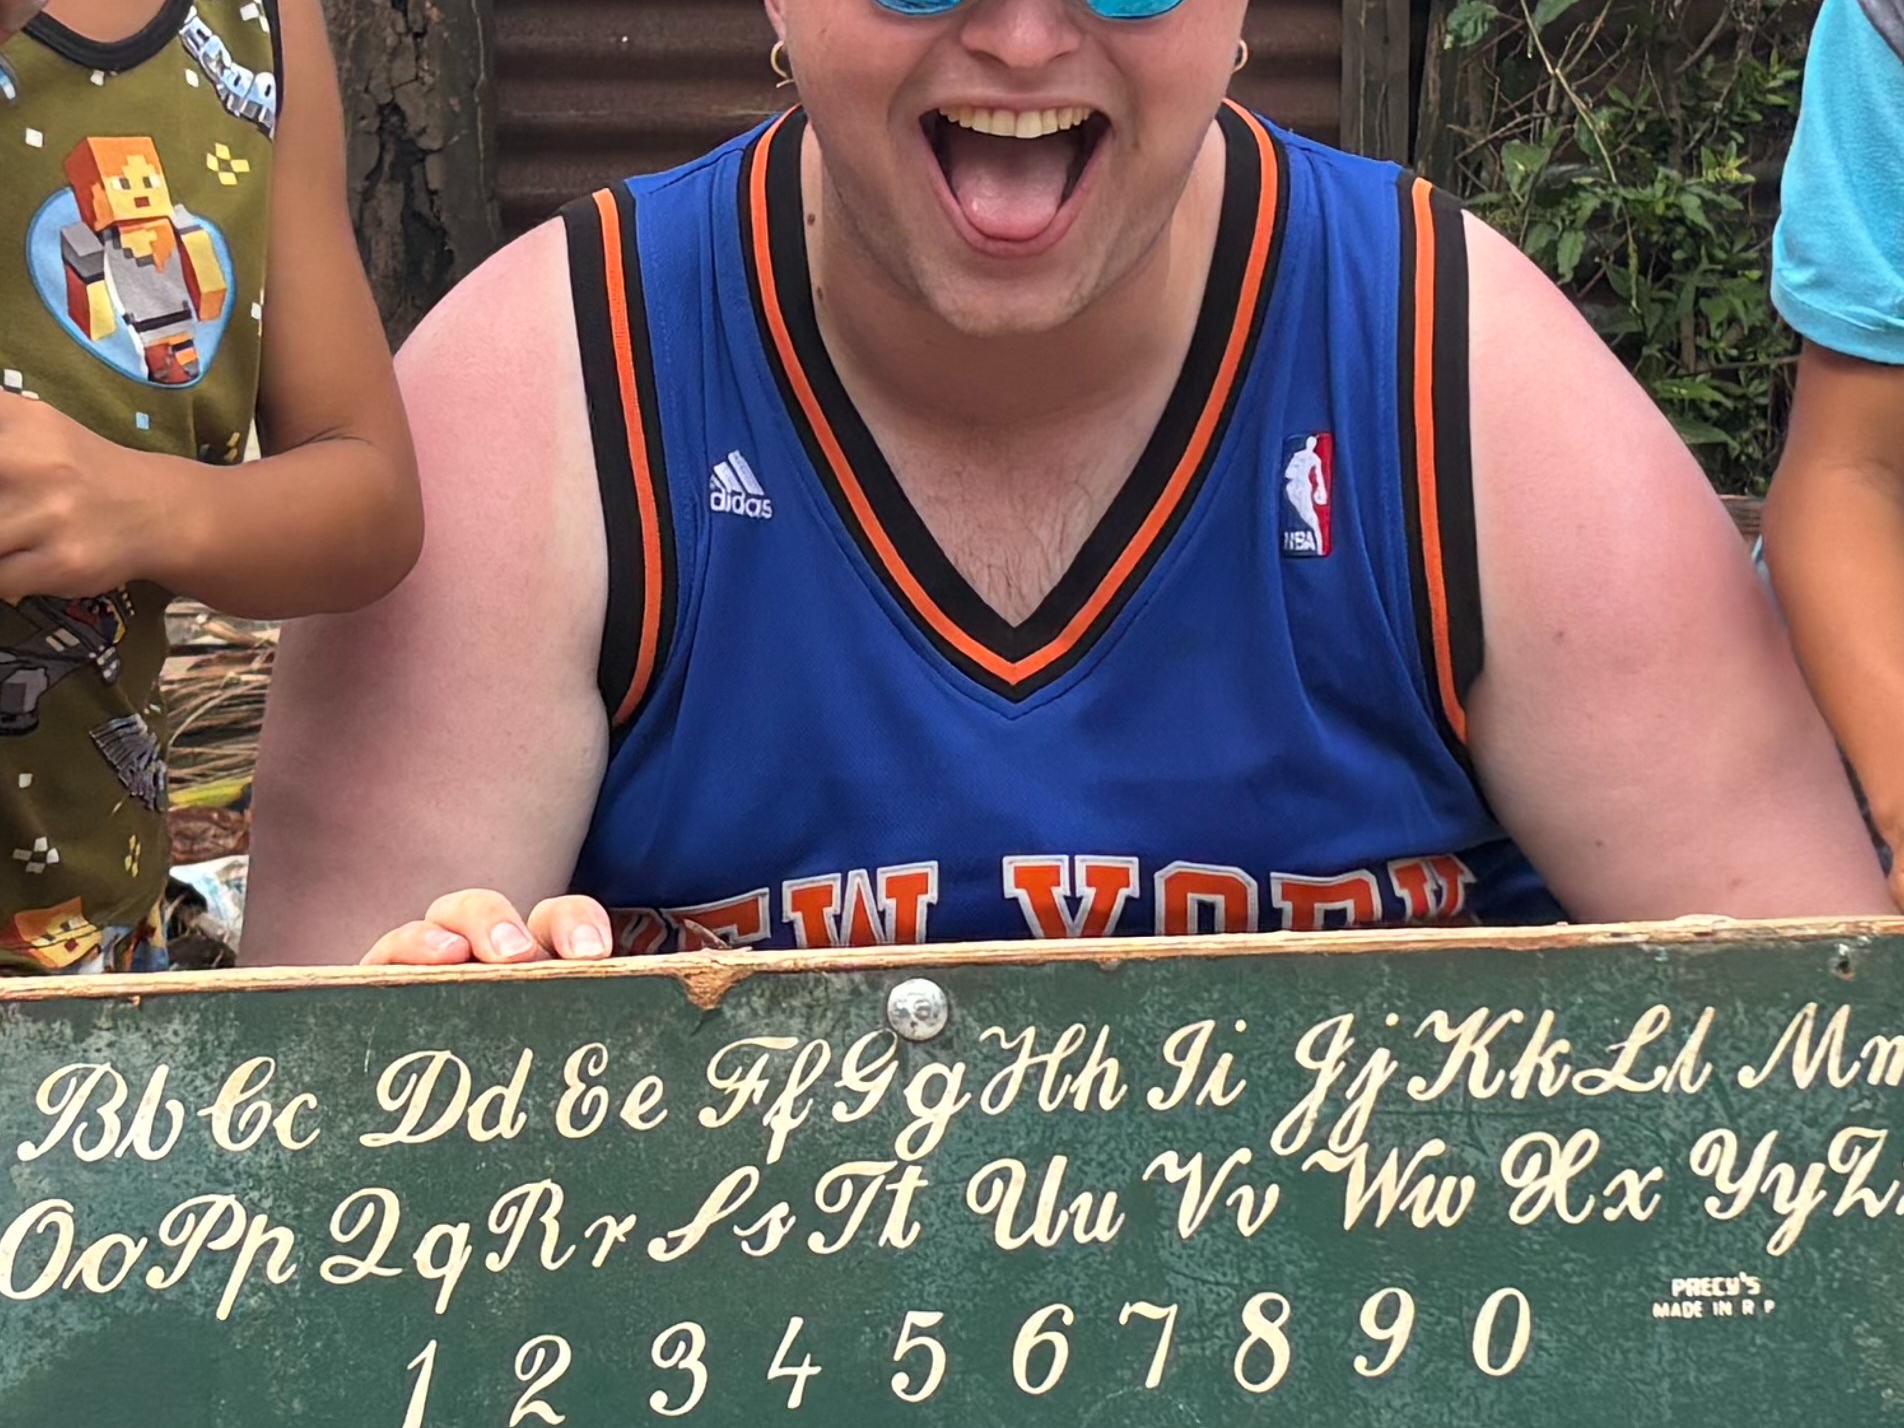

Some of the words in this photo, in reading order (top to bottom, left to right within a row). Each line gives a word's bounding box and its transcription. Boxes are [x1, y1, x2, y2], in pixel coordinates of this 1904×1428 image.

[710, 485, 774, 519] adidas
[1283, 530, 1317, 552] NBA
[16, 1060, 186, 1162] Bb
[197, 1056, 321, 1152] Cc
[359, 1047, 534, 1147] Dd
[555, 1042, 669, 1139] Ee
[698, 1035, 837, 1165] Ff
[831, 1029, 972, 1162] Gg
[979, 1023, 1128, 1115] Hh
[1147, 1018, 1248, 1111] Ii
[1271, 1009, 1400, 1156] Jj
[1407, 1006, 1571, 1101] Kk
[1571, 1004, 1714, 1096] Ll
[145, 1194, 297, 1321] Pp
[319, 1187, 473, 1315] Qq
[485, 1178, 637, 1272] Rr
[647, 1165, 797, 1262] Ss
[807, 1160, 929, 1254] Tt
[966, 1155, 1125, 1250] Uu
[1141, 1147, 1281, 1239] Vv
[1301, 1139, 1476, 1231] Ww
[1500, 1128, 1663, 1225] Xx
[1689, 1127, 1827, 1256] Yy
[1671, 1271, 1761, 1297] PRECY'S
[1652, 1300, 1703, 1318] MADE
[1712, 1300, 1733, 1316] IN
[1742, 1299, 1755, 1315] R
[1764, 1299, 1775, 1314] P
[508, 1334, 572, 1428] 2
[648, 1321, 708, 1416] 3
[766, 1315, 822, 1409] 4
[891, 1310, 946, 1403] 5
[1011, 1303, 1074, 1395] 6
[1117, 1300, 1178, 1389] 7
[1233, 1292, 1291, 1393] 8
[1353, 1287, 1415, 1377] 9
[1472, 1287, 1532, 1376] 0
